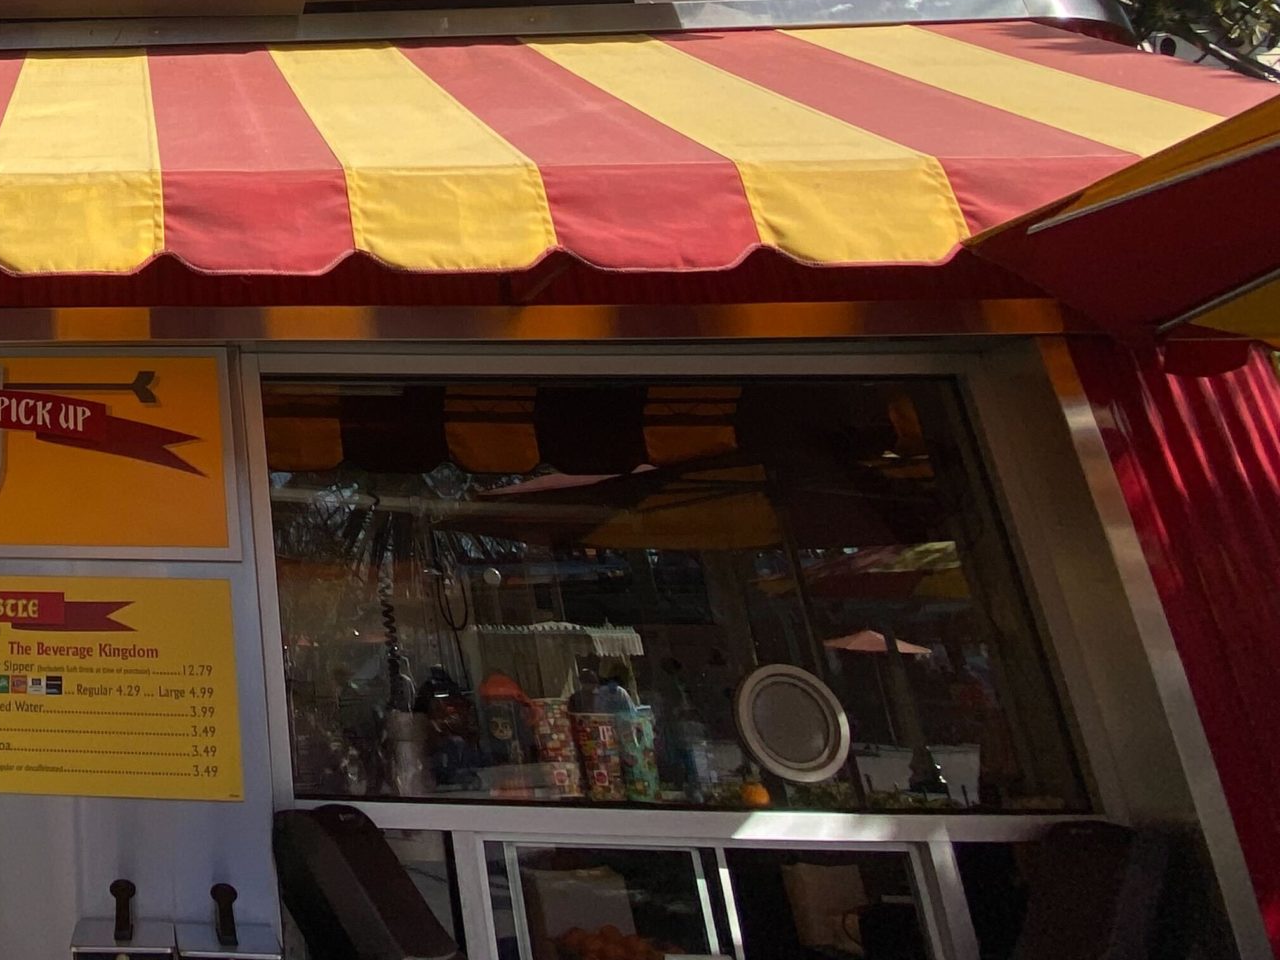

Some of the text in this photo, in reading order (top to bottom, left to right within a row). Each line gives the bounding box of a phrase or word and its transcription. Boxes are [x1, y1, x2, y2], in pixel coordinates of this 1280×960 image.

[58, 404, 92, 432] UP
[8, 641, 159, 661] The Beverage Kingdom
[3, 660, 35, 676] Sipper
[182, 665, 213, 677] 12.79
[76, 684, 113, 698] Regular
[116, 685, 141, 697] 4.29
[158, 686, 186, 700] Large
[189, 687, 214, 699] 4.99
[15, 701, 44, 713] Water
[190, 706, 215, 718] 3.99
[191, 726, 216, 738] 3.49
[192, 745, 217, 757] 3.49
[193, 765, 218, 777] 3.49
